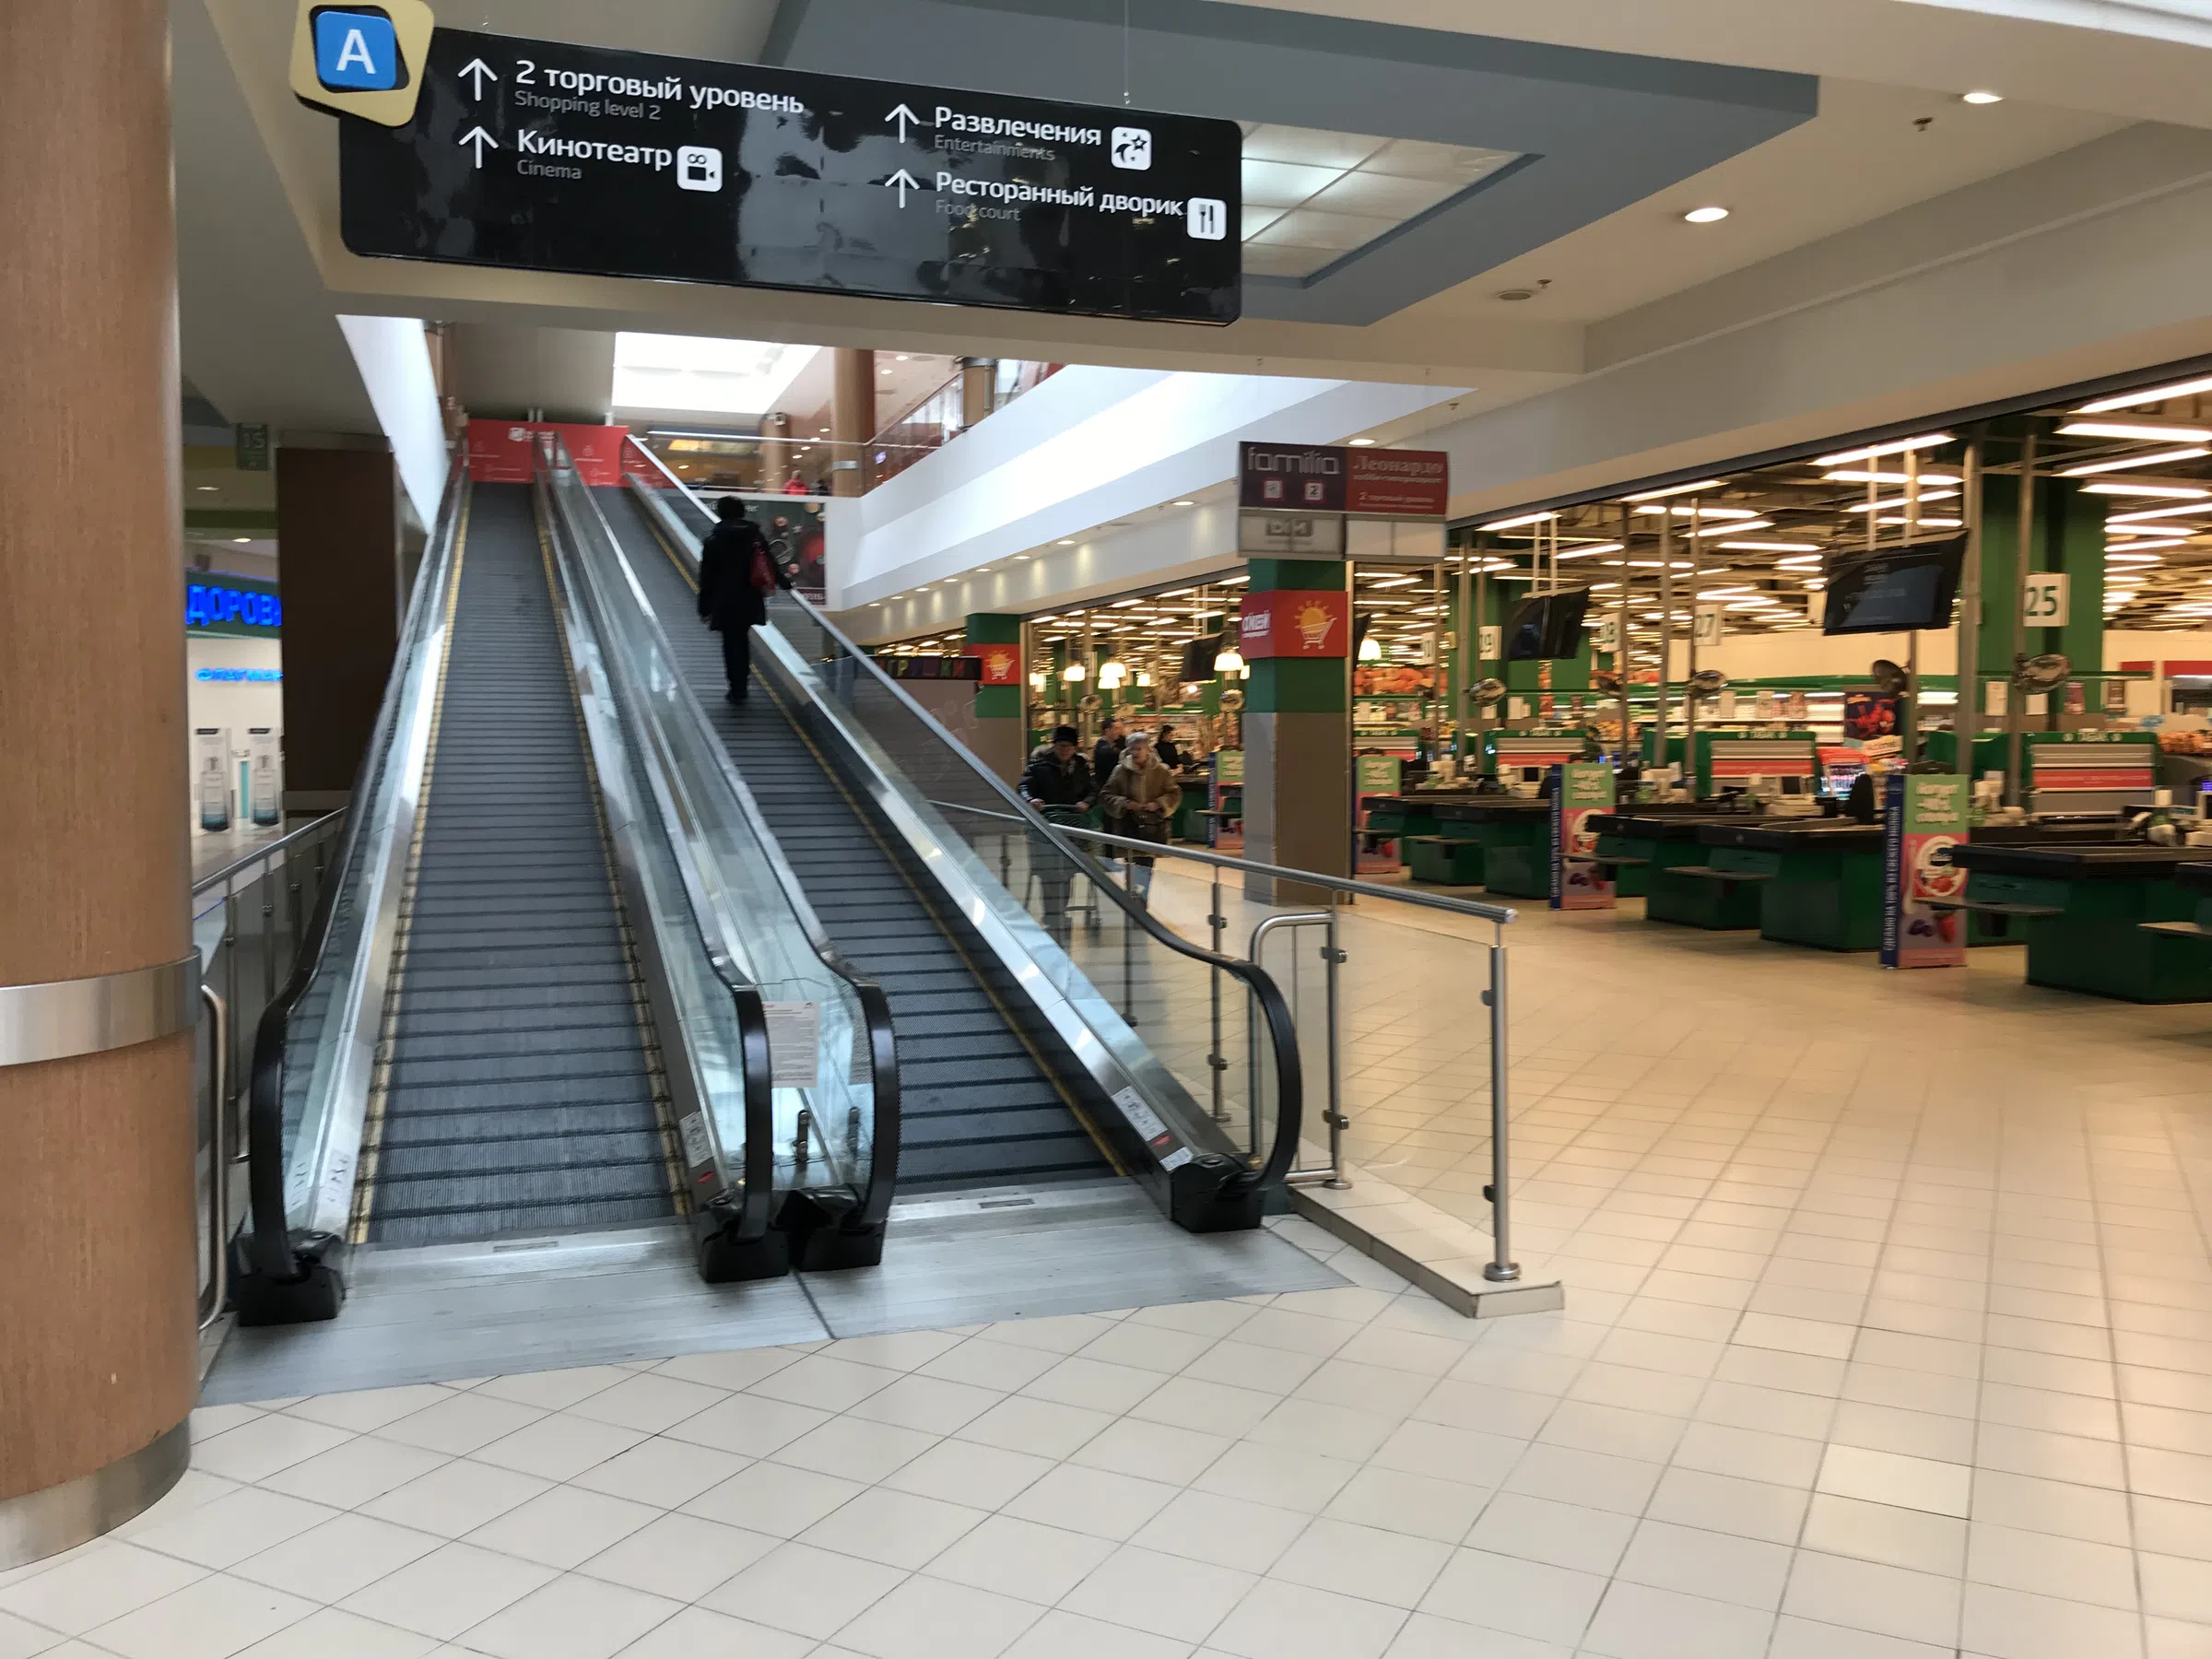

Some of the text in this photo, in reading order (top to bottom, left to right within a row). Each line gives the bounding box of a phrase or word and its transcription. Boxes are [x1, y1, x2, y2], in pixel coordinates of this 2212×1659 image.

[515, 61, 805, 115] 2 торговый уровень
[514, 89, 662, 121] Shopping level 2
[935, 107, 1102, 147] Развлечения
[516, 129, 674, 170] Кинотеатр
[934, 134, 1056, 161] Entertainments
[516, 159, 582, 181] Cinema
[935, 171, 1184, 218] Ресторанный дворик
[935, 199, 1022, 221] Food court
[2024, 585, 2057, 617] 25
